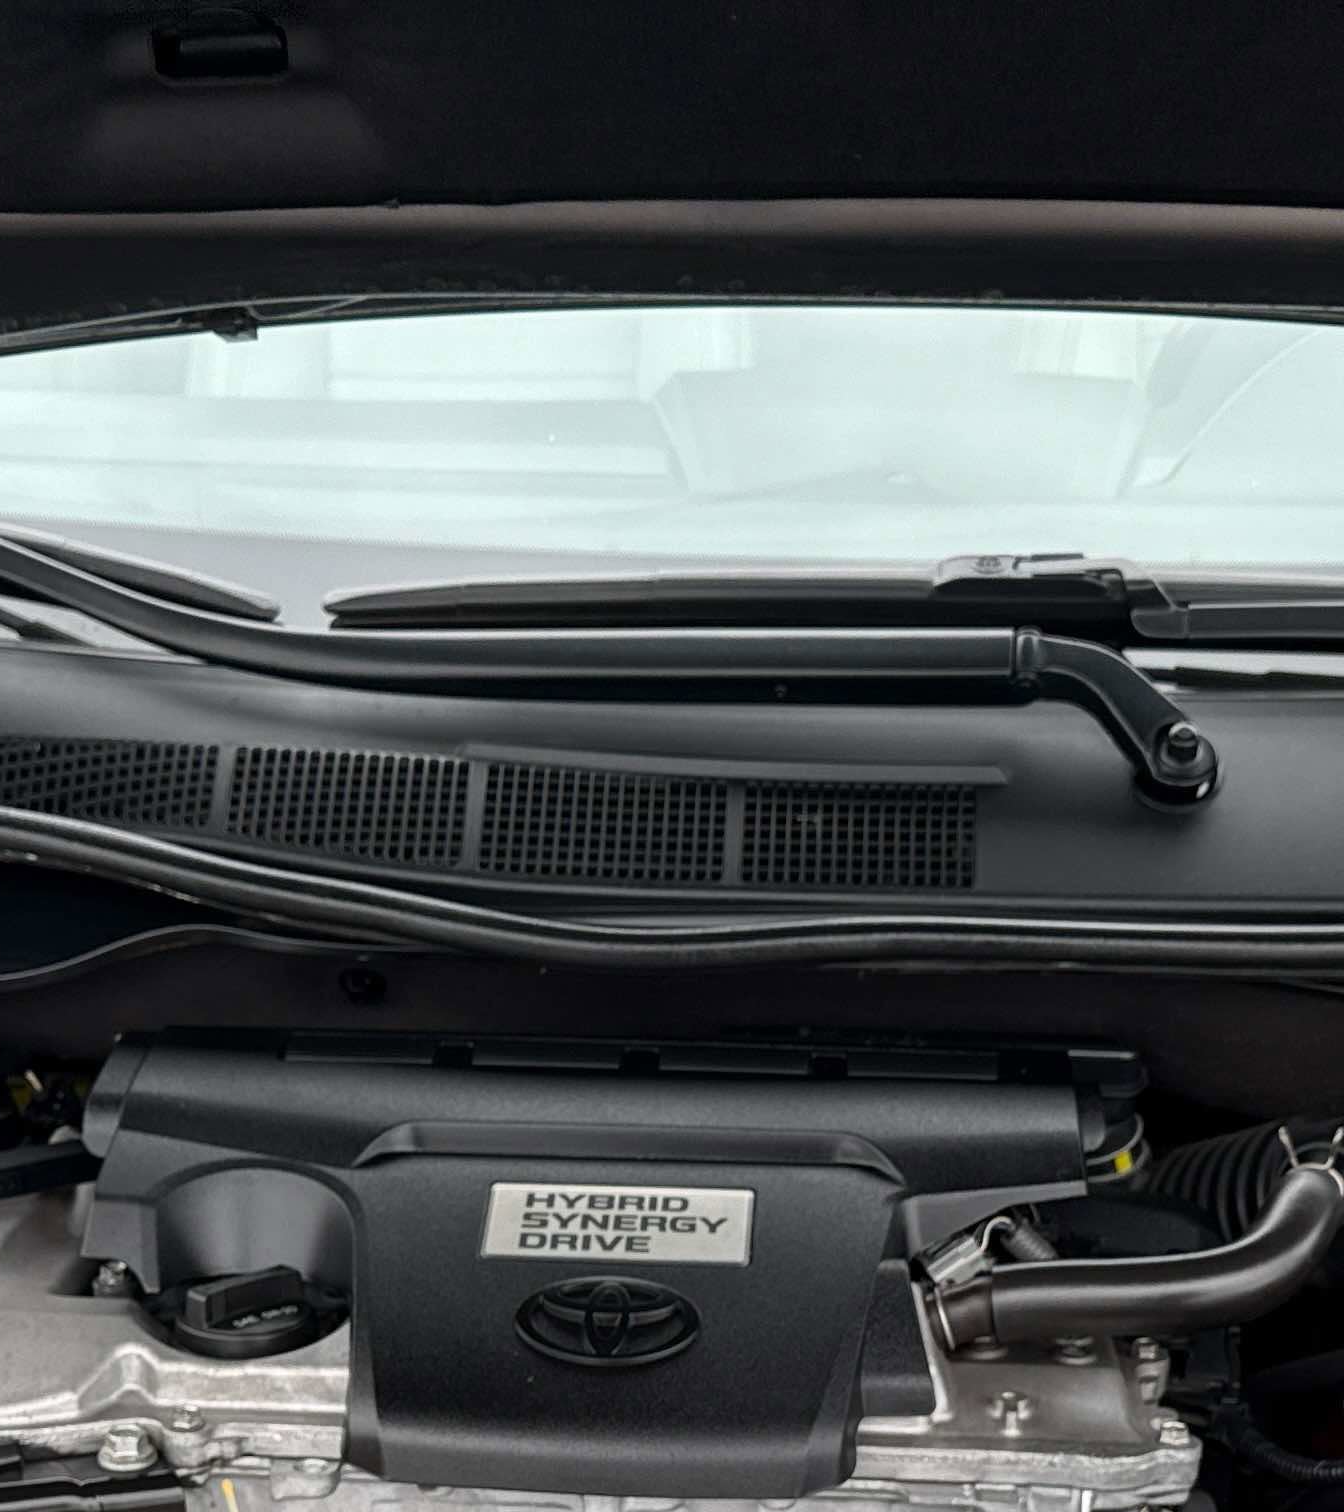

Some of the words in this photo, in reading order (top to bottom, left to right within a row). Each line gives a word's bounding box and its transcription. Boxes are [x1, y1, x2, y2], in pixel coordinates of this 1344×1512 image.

[525, 1192, 689, 1213] HYBRID
[521, 1212, 729, 1234] SYNERGY
[518, 1232, 652, 1254] DRIVE
